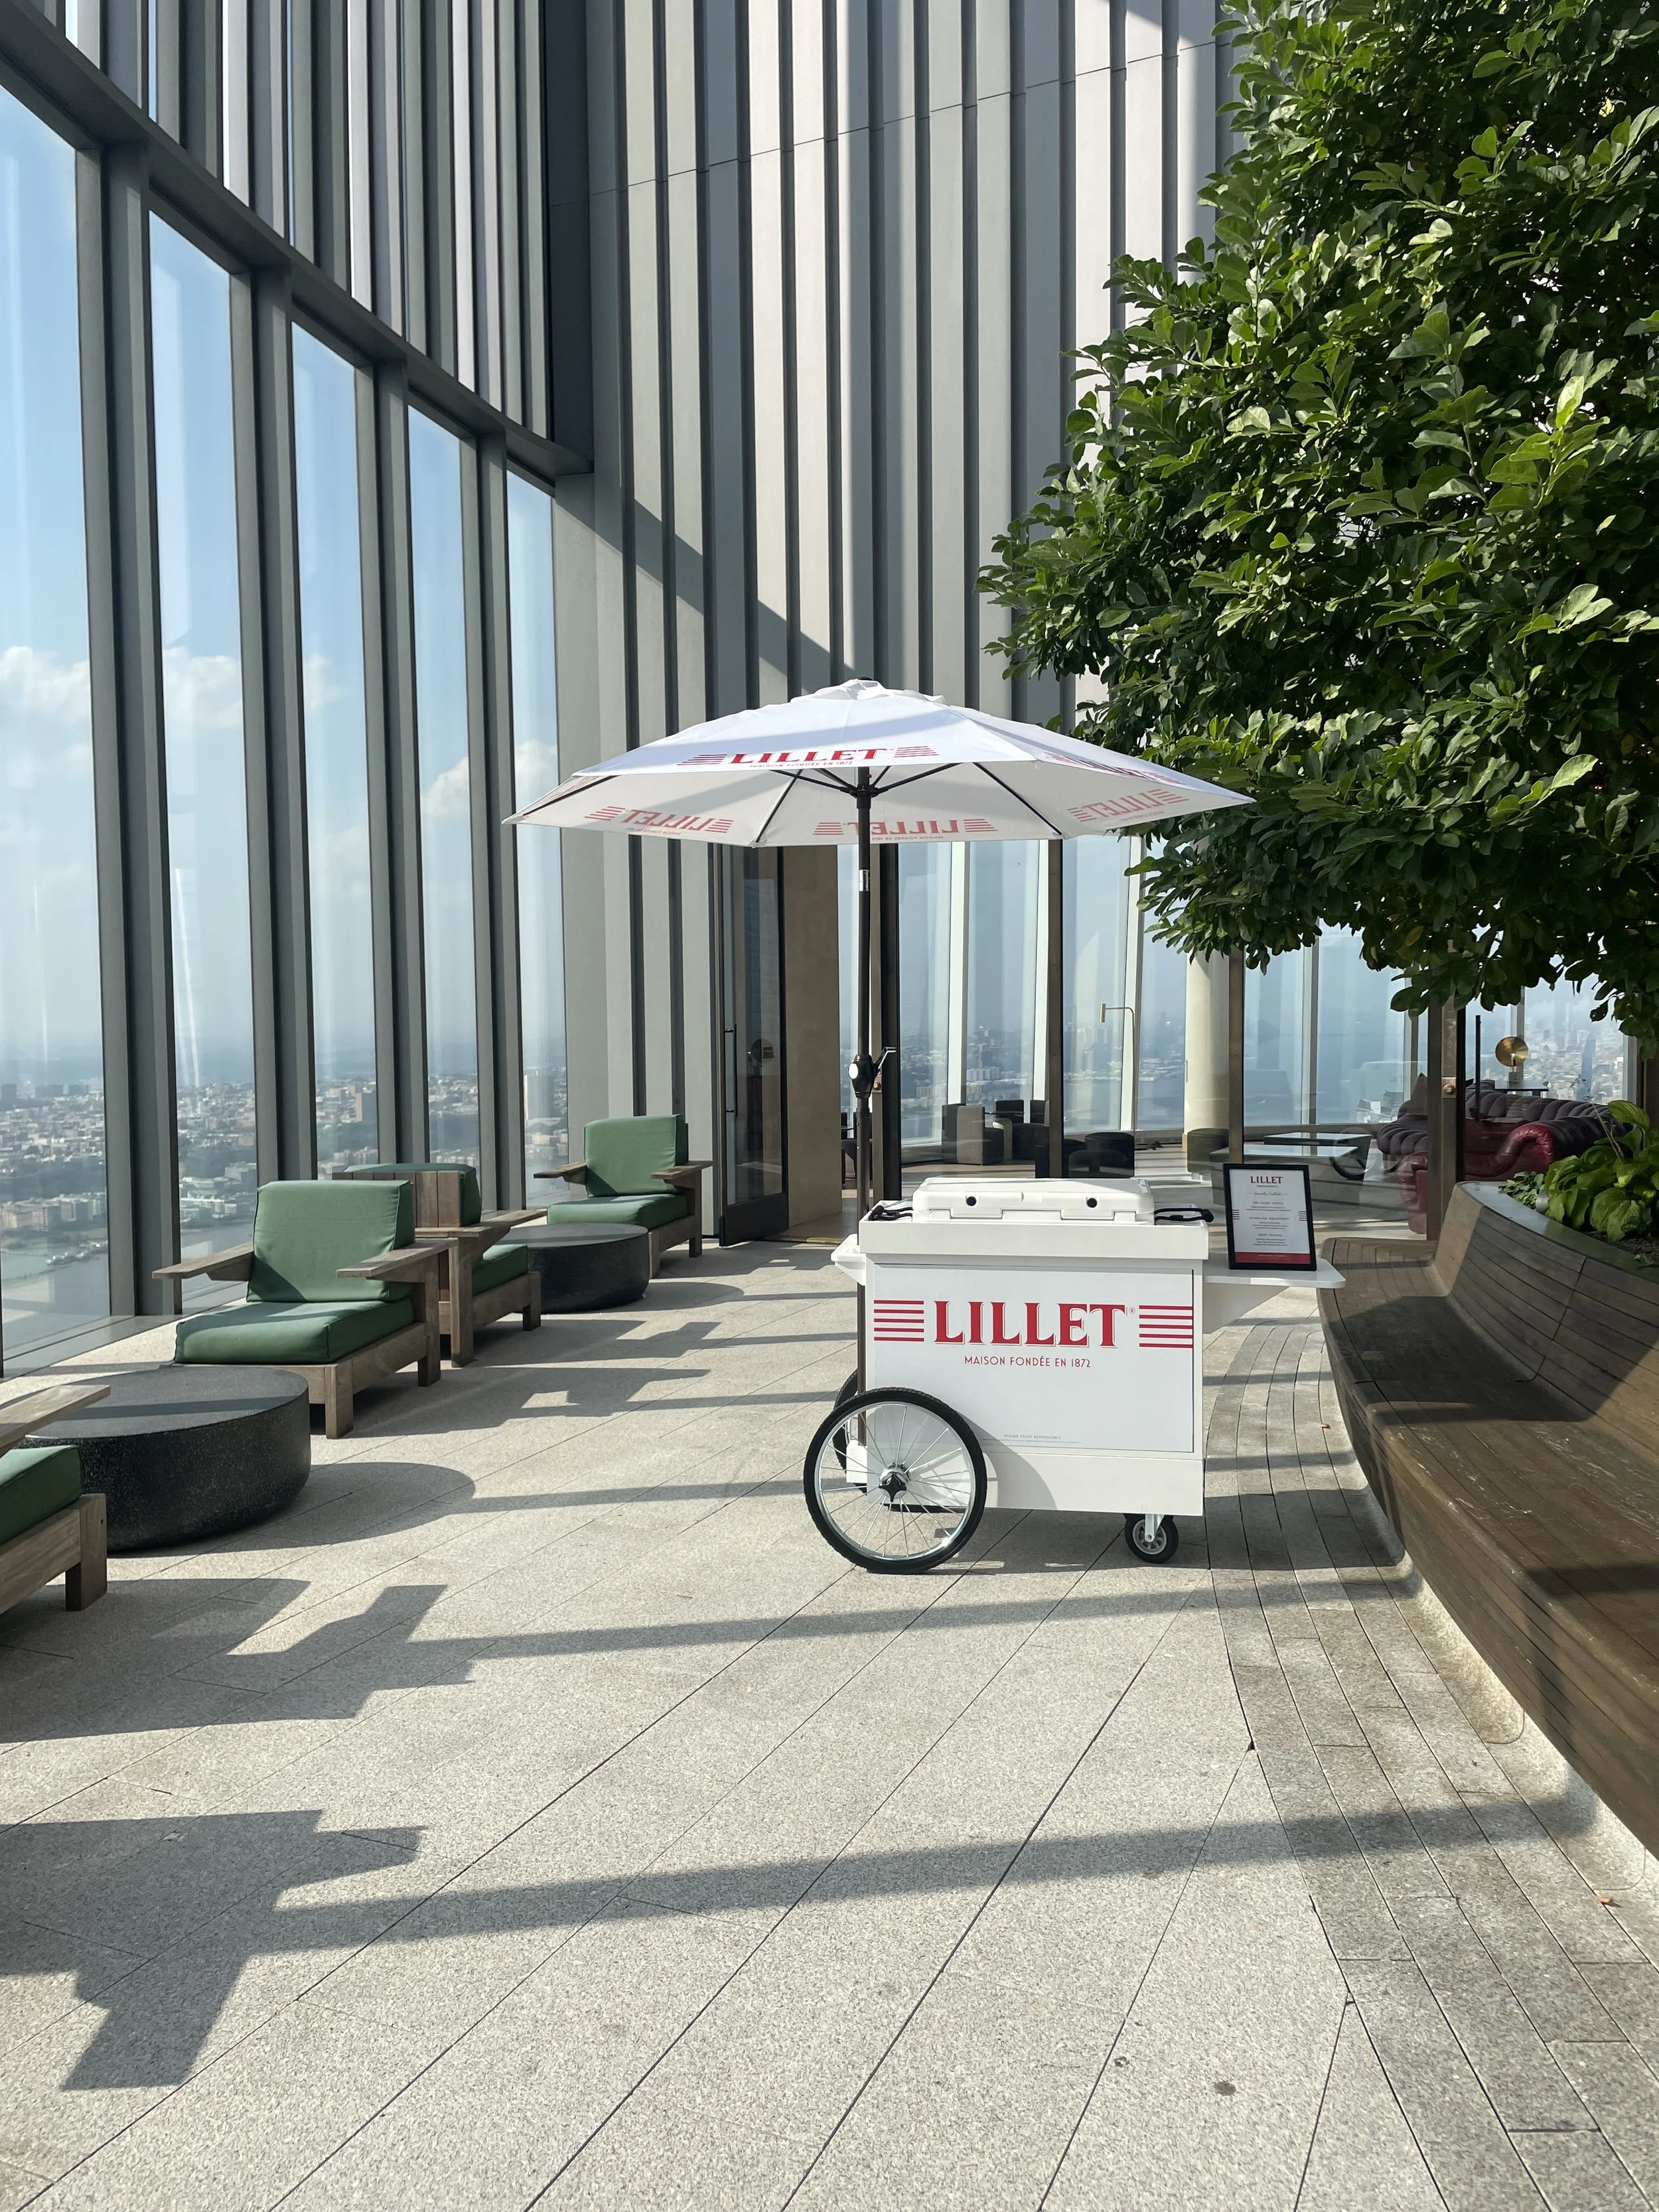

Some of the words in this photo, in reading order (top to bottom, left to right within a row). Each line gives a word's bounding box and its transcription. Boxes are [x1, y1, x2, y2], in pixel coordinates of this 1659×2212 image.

[729, 748, 887, 765] LILLET
[964, 1356, 1006, 1366] MAISON
[1009, 1355, 1050, 1367] FONDÉE
[1054, 1358, 1066, 1367] EN
[1070, 1359, 1091, 1368] 1872
